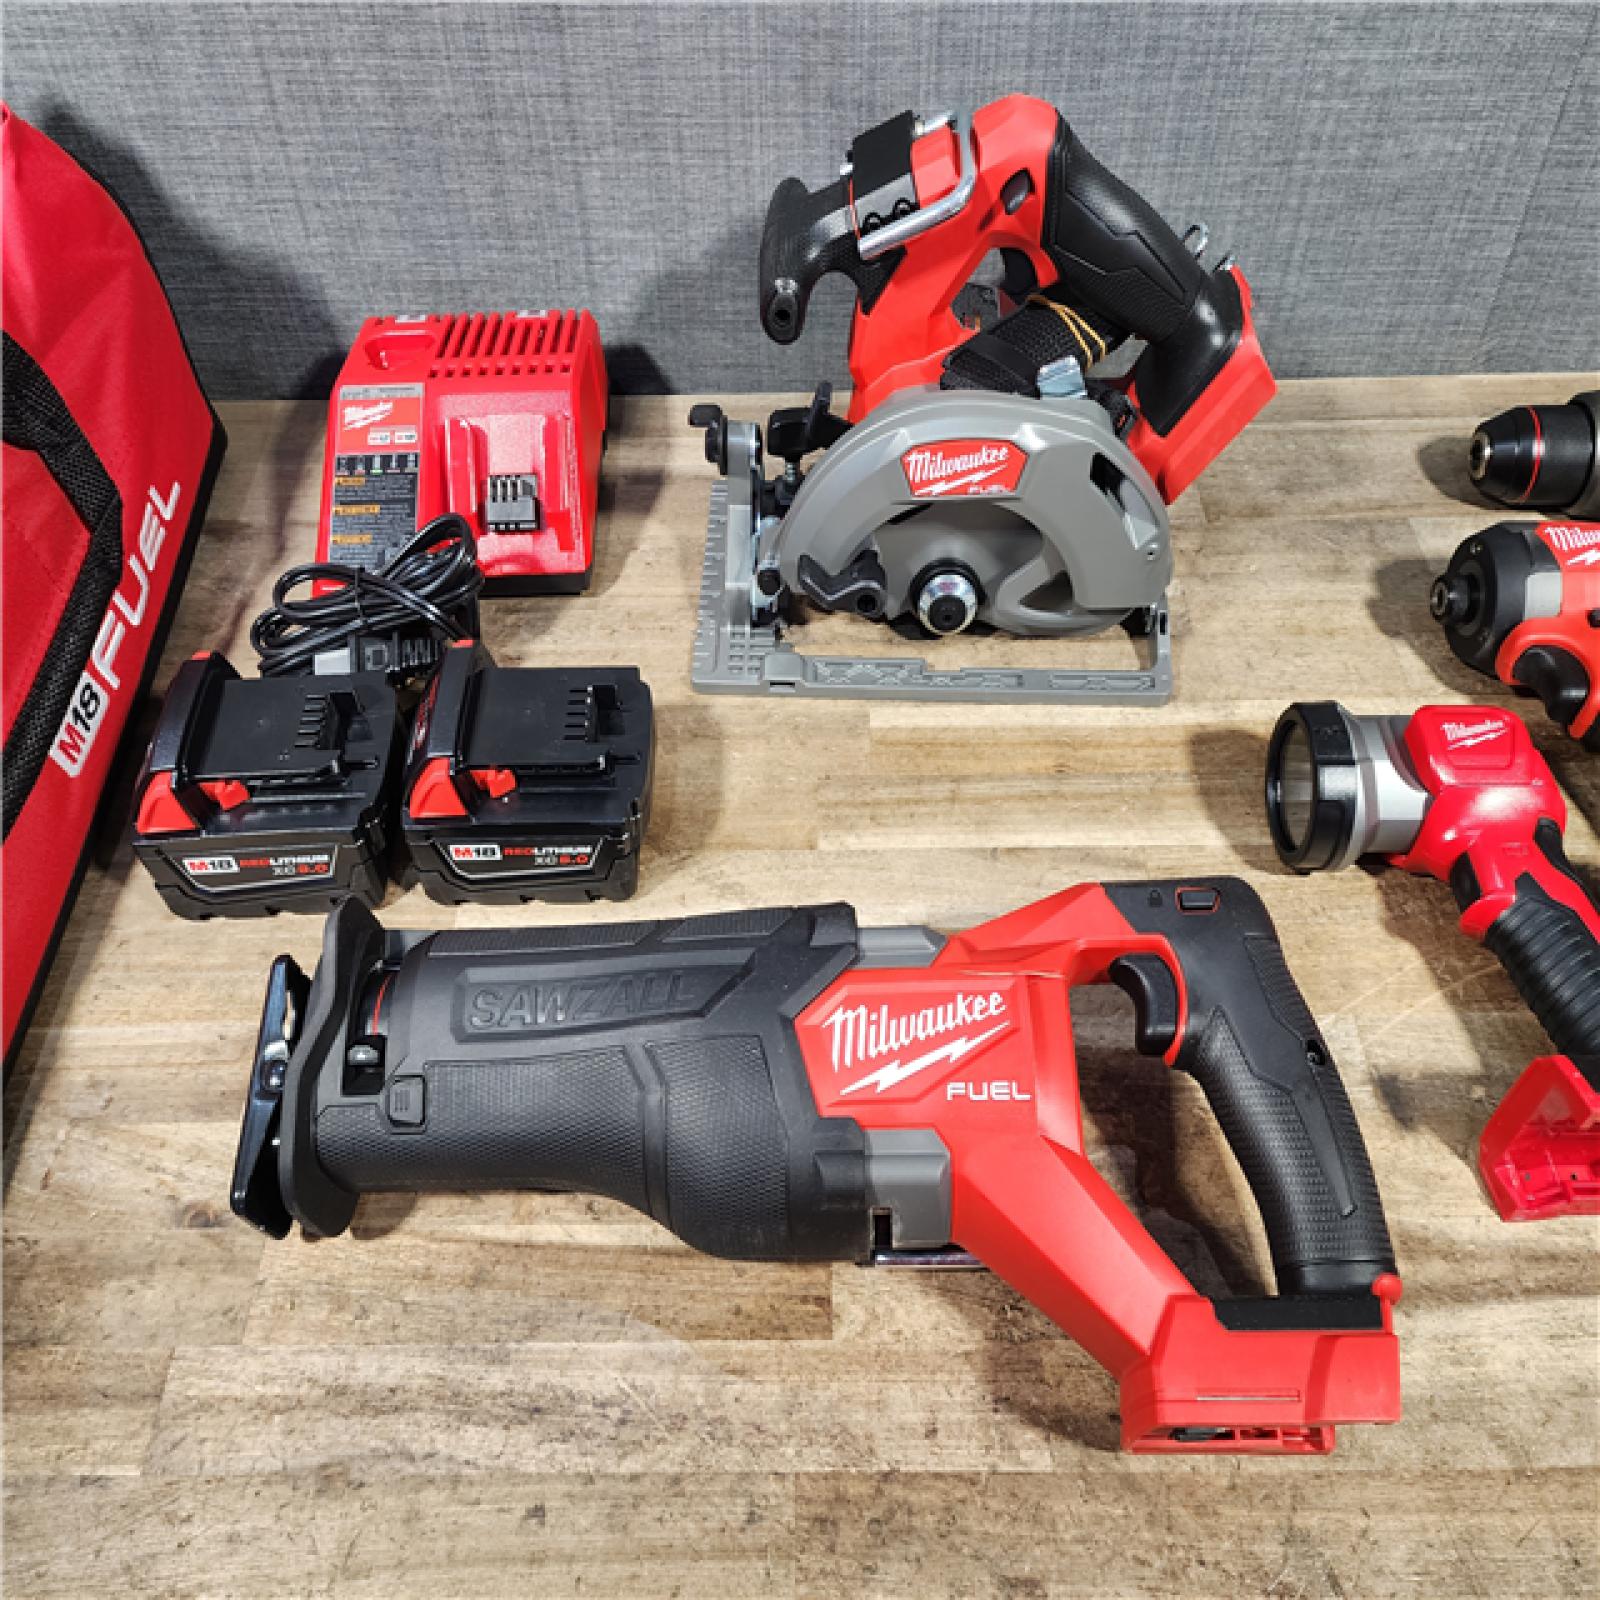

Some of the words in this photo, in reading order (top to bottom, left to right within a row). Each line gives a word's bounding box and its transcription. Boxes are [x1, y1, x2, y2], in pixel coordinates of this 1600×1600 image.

[906, 445, 1008, 482] Milwaukee
[57, 684, 101, 764] M18
[91, 481, 181, 690] FUEL
[187, 858, 233, 871] M18
[453, 846, 496, 858] M18
[470, 973, 695, 1030] SAWZALL
[821, 992, 1006, 1073] Milwaukee
[946, 1082, 1031, 1100] FUEL
